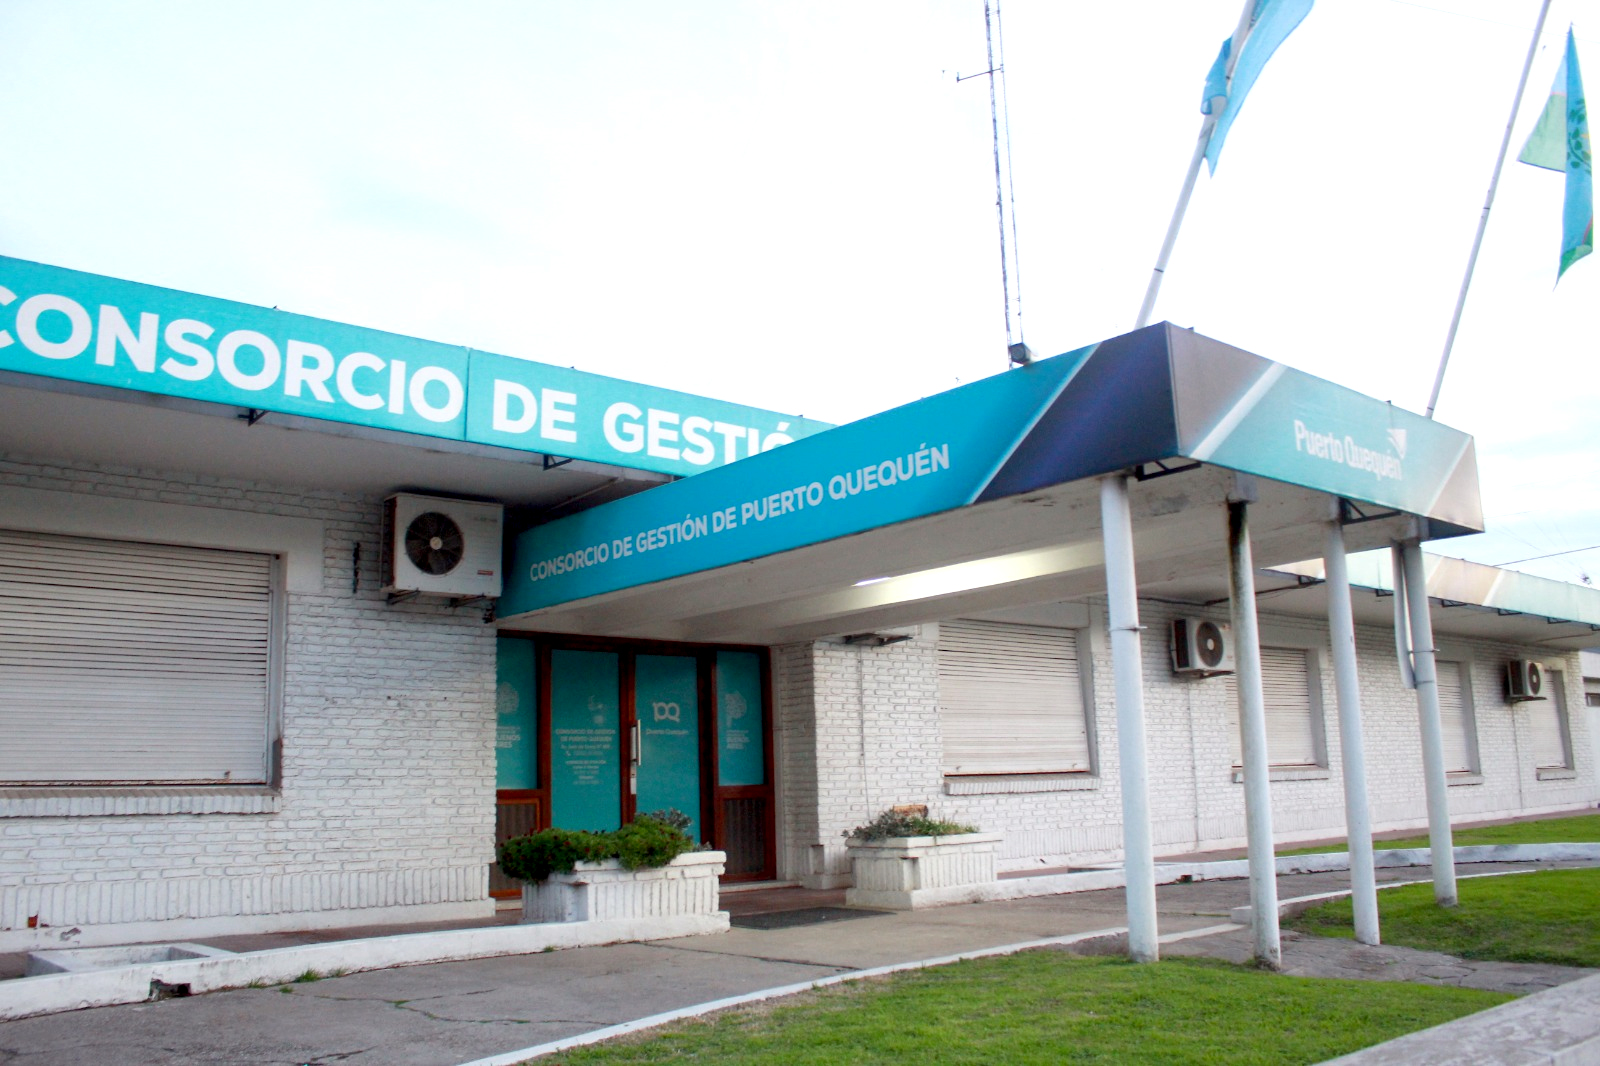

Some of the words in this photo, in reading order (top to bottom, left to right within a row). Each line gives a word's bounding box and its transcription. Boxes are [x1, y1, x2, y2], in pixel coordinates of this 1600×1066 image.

[0, 285, 465, 424] ONSORCIO
[492, 379, 578, 444] DE
[1293, 419, 1345, 464] Puerto
[529, 542, 610, 582] CONSORCIO
[612, 536, 633, 560] DE
[635, 513, 708, 553] GESTIÓN
[712, 506, 737, 533] DE
[741, 482, 824, 525] PUERTO
[828, 442, 950, 500] QUEQUÉN
